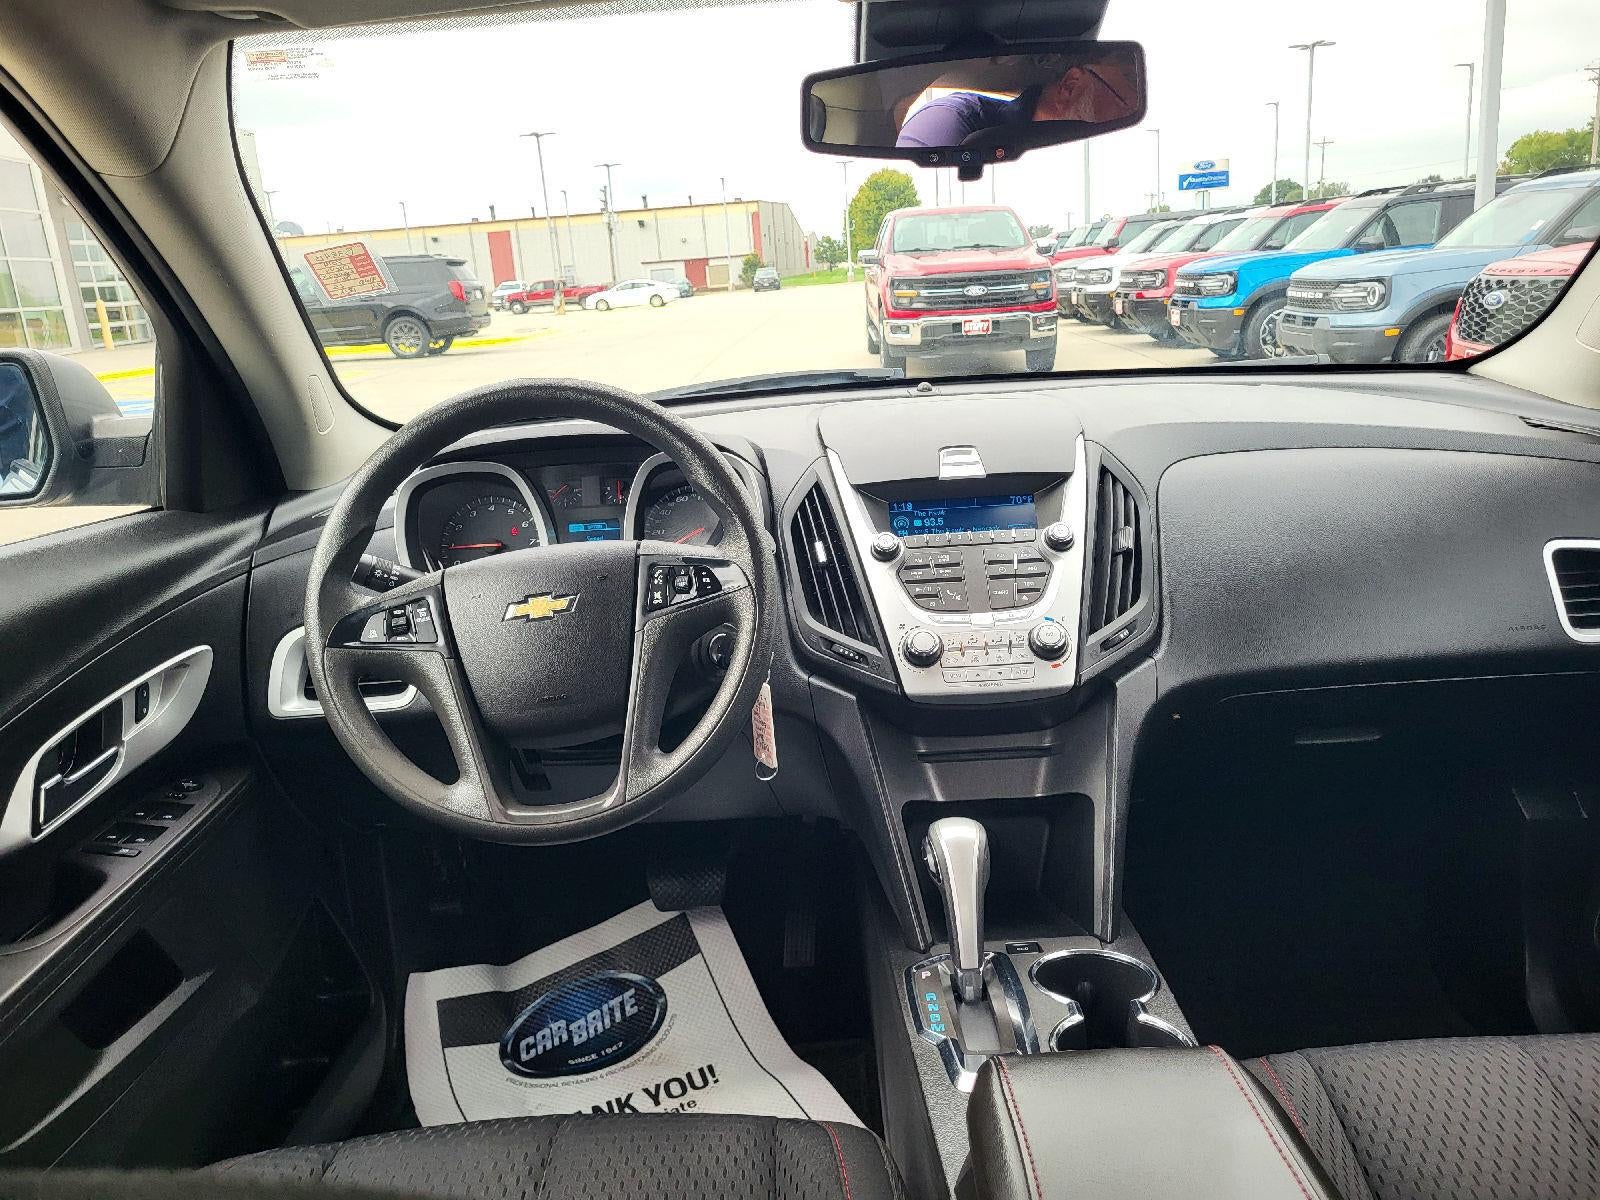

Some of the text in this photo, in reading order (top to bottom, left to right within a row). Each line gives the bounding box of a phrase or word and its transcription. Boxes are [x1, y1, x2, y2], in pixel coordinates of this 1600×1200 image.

[675, 495, 689, 503] 60
[488, 504, 495, 512] 4
[521, 520, 529, 528] 6
[923, 517, 944, 527] 93.5
[529, 538, 536, 546] 7
[922, 971, 931, 979] P
[519, 987, 639, 1062] CAR BRITE
[567, 1054, 599, 1065] SINCE
[642, 1064, 719, 1107] YOU!
